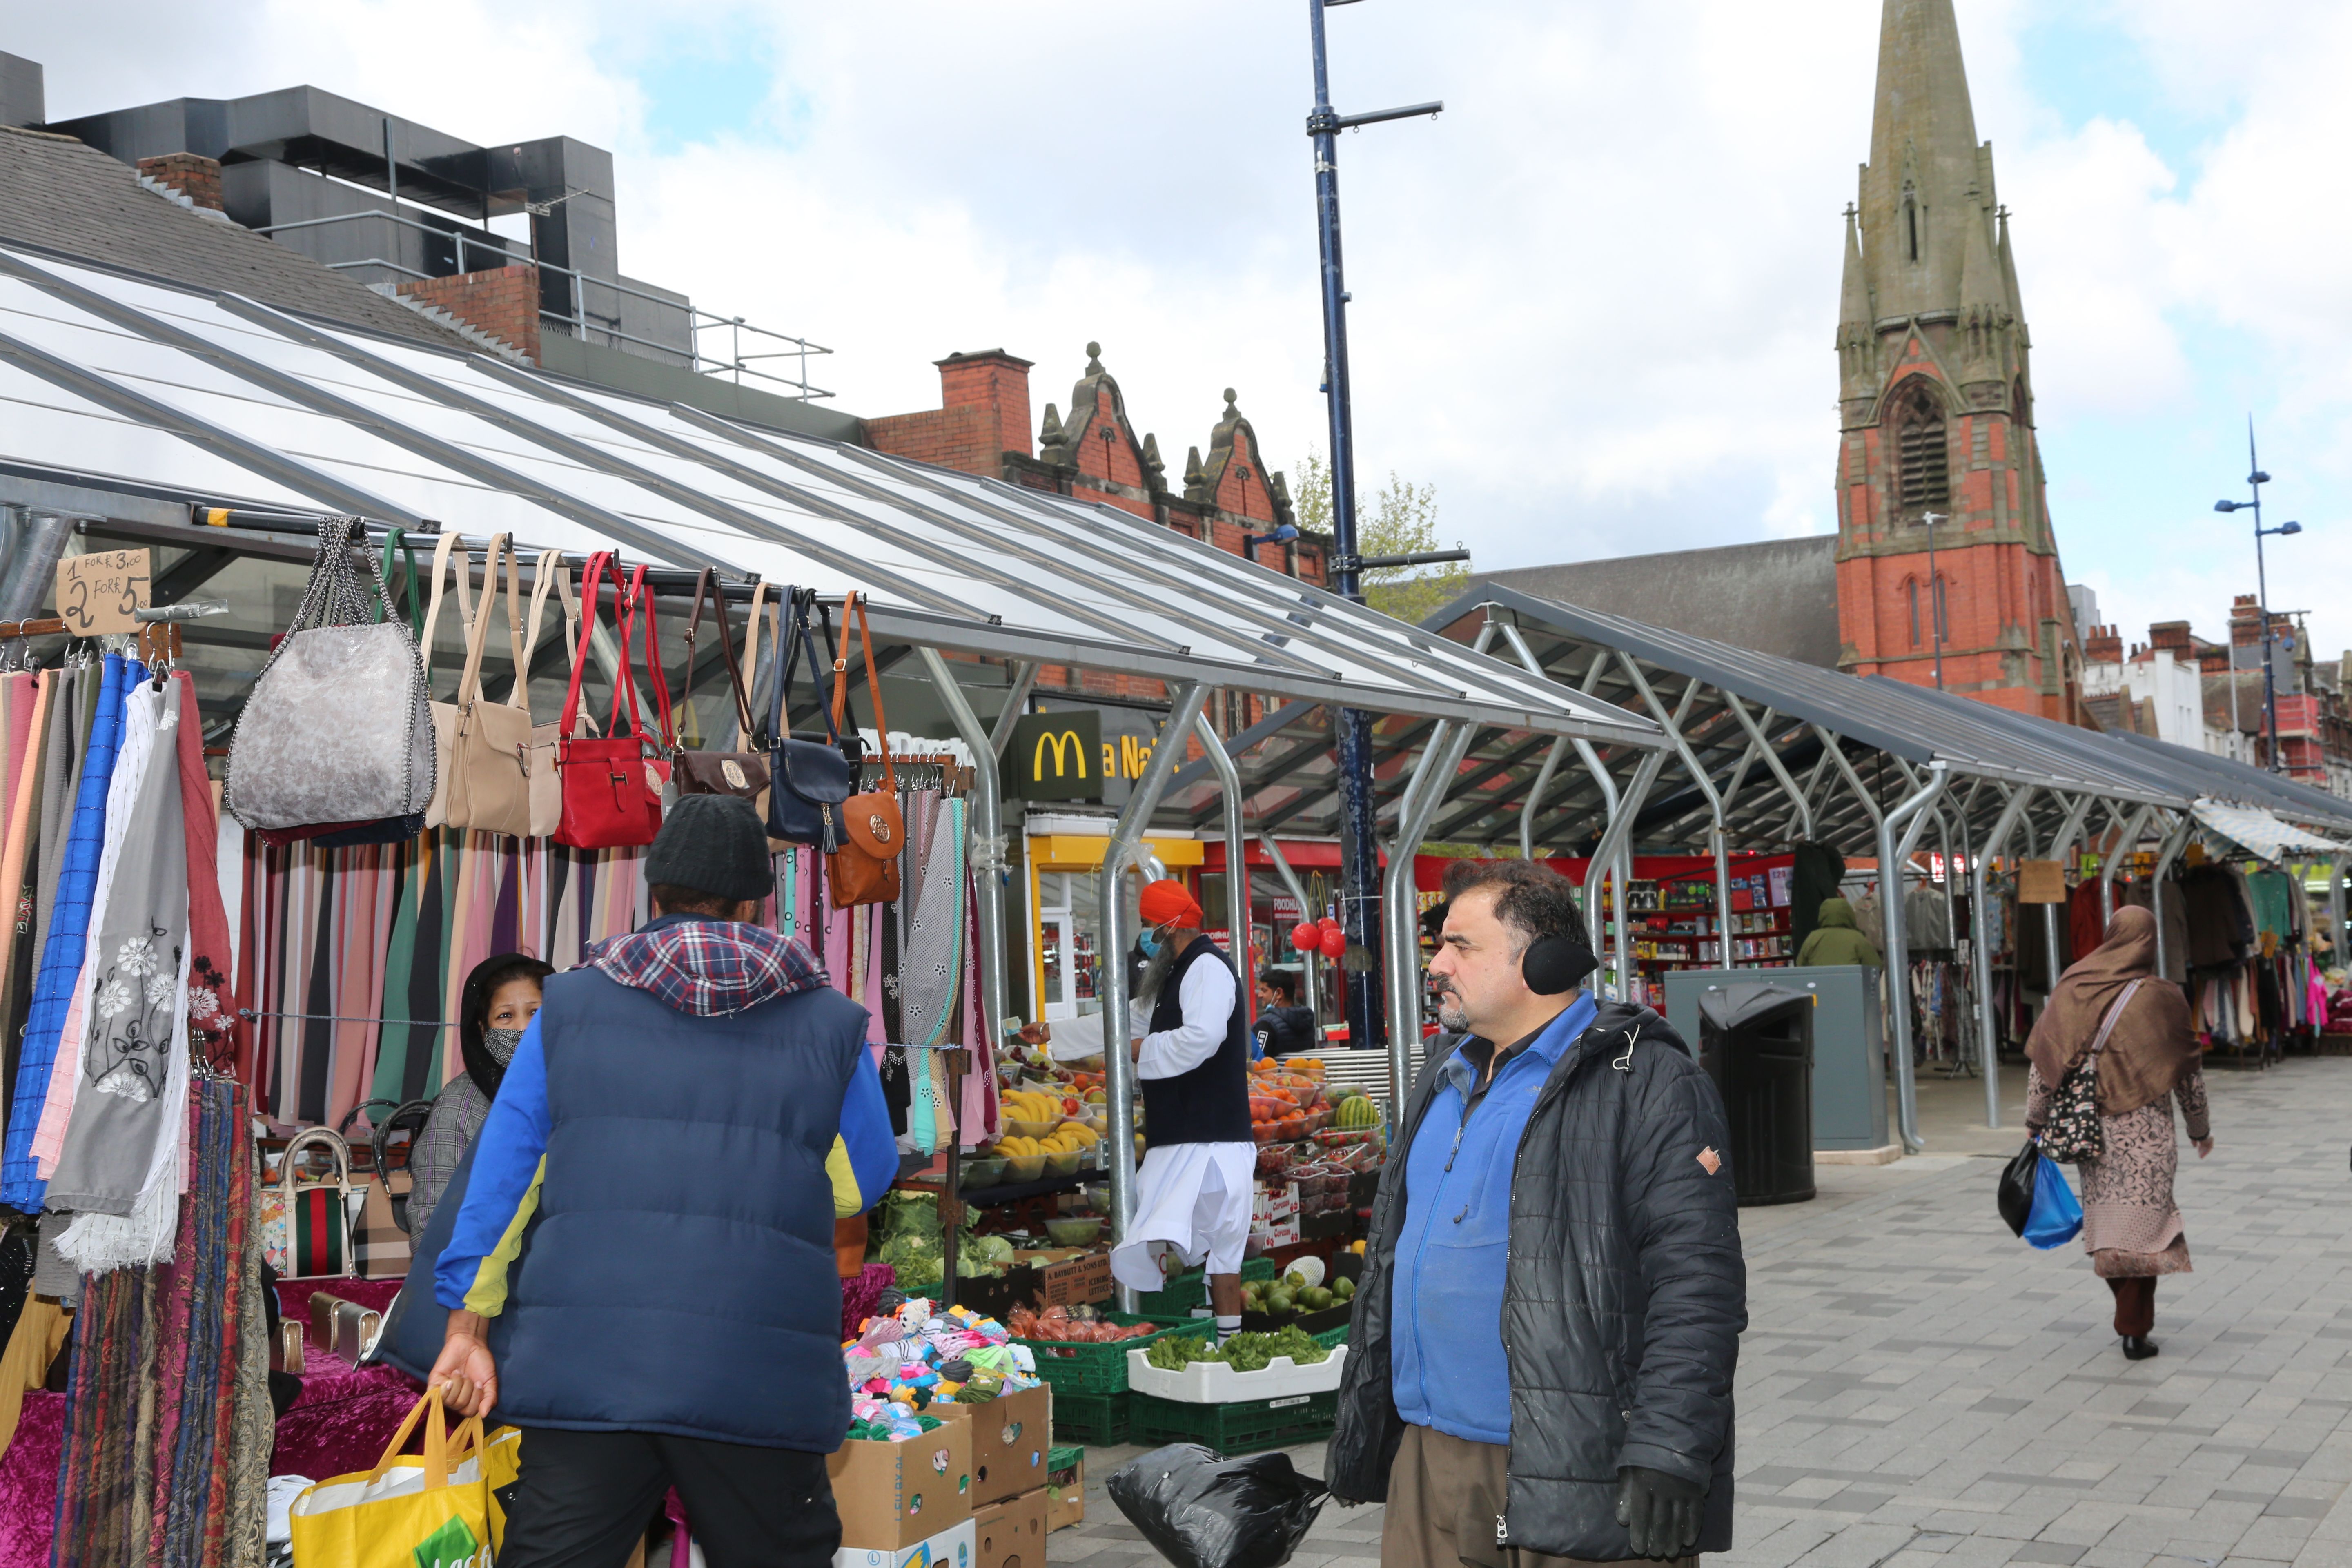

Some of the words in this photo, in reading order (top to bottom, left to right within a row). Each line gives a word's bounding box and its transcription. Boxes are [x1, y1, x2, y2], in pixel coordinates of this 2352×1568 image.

[67, 560, 81, 581] 1
[85, 556, 103, 568] FOR
[66, 581, 94, 628] 2
[1274, 898, 1301, 911] FOODHU
[1054, 1266, 1076, 1278] BAYBUTT
[1084, 1261, 1097, 1272] SONS
[1089, 1274, 1109, 1286] ICEBERG
[1089, 1284, 1109, 1296] LETTUCE
